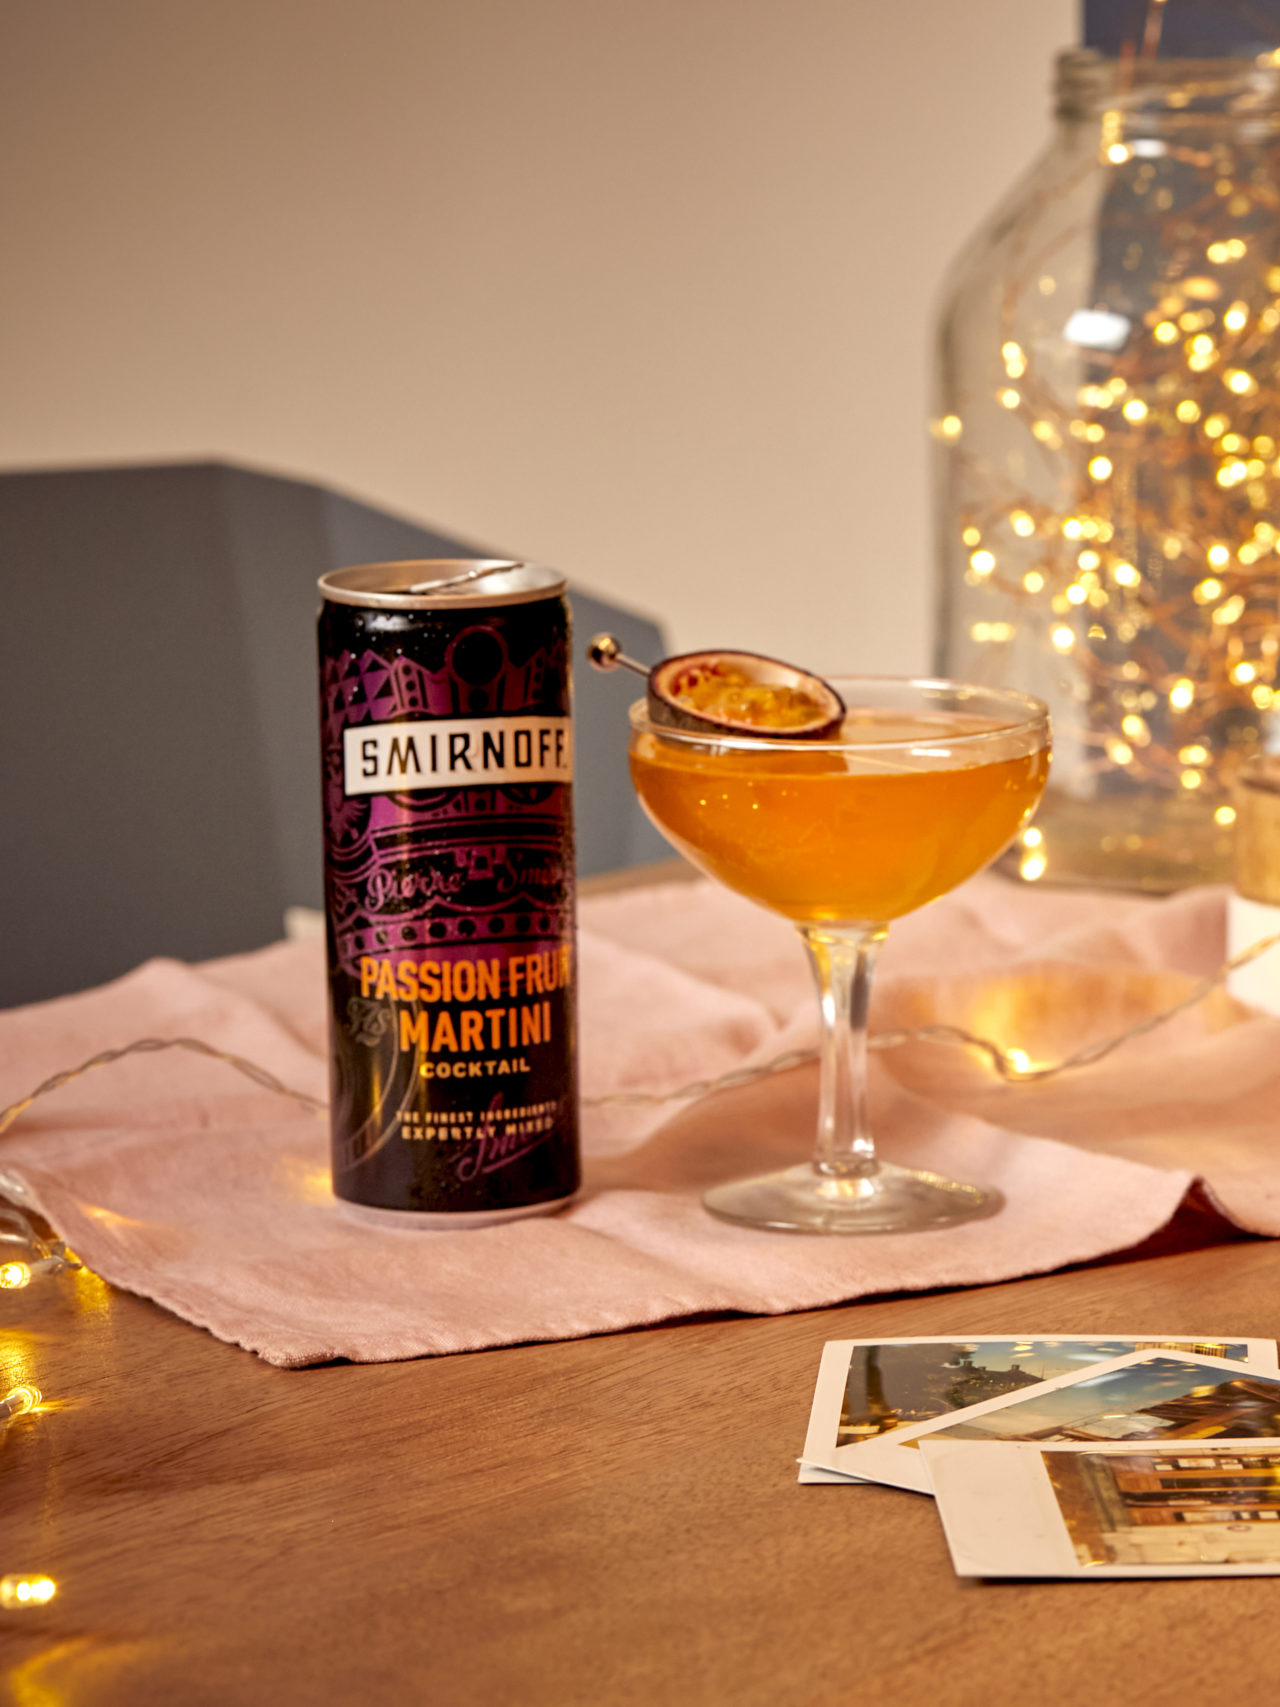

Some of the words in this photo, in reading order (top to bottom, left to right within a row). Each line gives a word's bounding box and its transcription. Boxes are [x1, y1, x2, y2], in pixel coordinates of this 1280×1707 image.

[361, 729, 564, 777] SMIRNOFF
[360, 955, 500, 1003] PASSION
[400, 1001, 551, 1053] MARTINI
[419, 1057, 531, 1079] COCKTAIL
[401, 1126, 497, 1141] EXPERTLY
[505, 1116, 554, 1137] MIXED
[425, 1111, 474, 1124] FINEST
